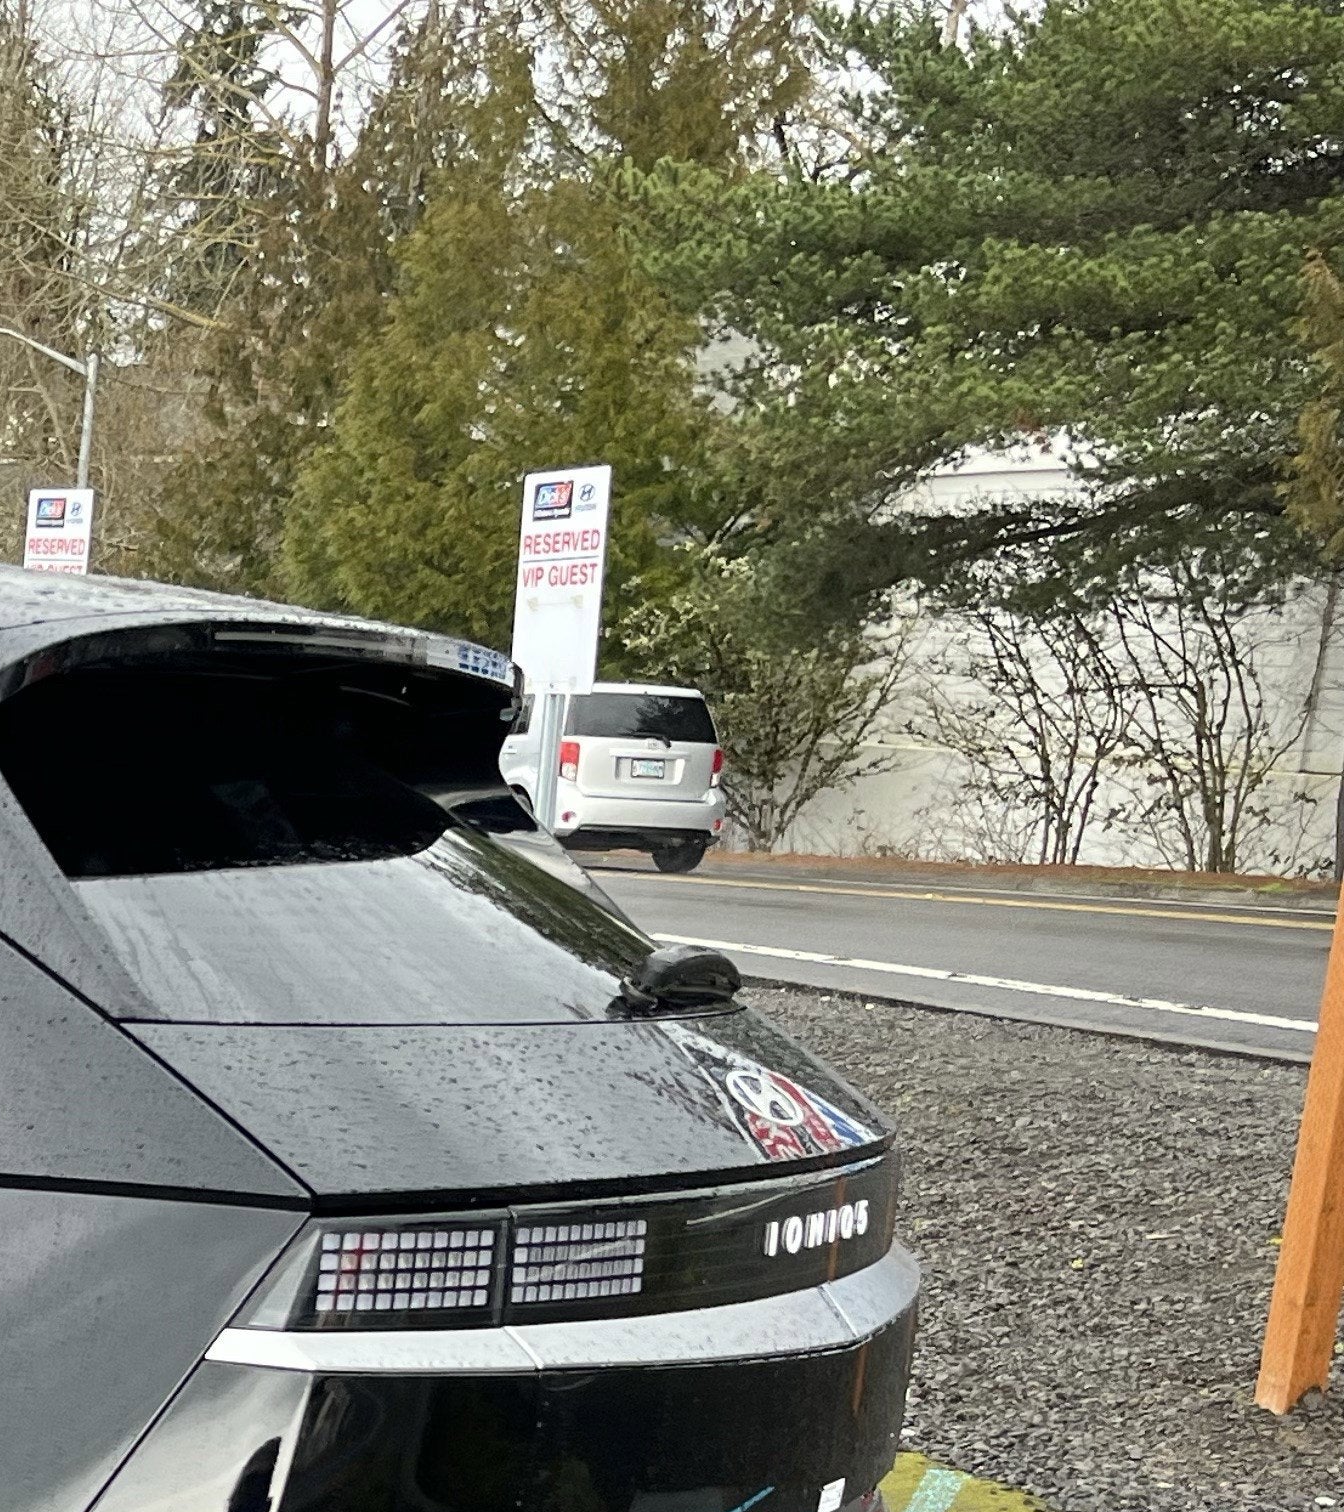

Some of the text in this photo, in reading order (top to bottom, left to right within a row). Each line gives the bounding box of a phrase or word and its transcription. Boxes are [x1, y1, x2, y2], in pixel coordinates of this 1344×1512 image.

[28, 538, 86, 556] RESERVED
[523, 529, 601, 555] RESERVED
[523, 563, 598, 588] VIP GUEST
